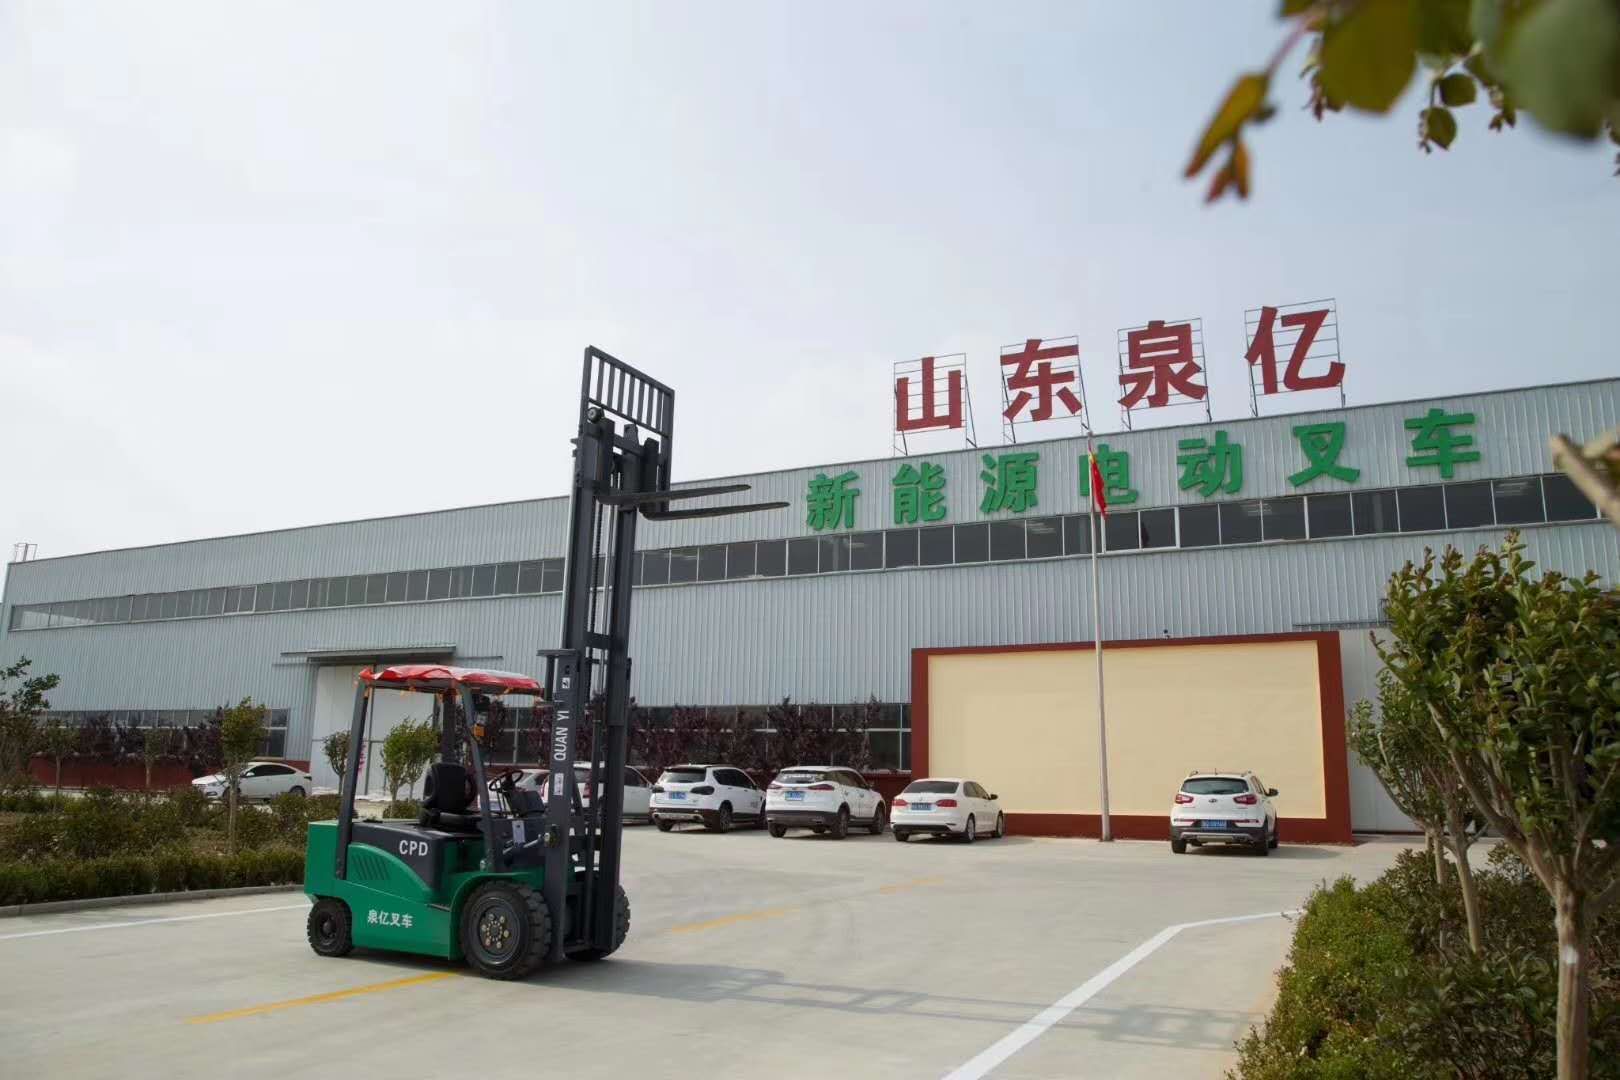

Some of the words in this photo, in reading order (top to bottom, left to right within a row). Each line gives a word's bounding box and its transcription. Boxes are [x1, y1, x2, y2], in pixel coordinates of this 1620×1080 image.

[896, 305, 1344, 431] 山东泉亿
[806, 408, 1481, 530] 新能源电动叉车
[556, 710, 570, 721] YI
[553, 726, 568, 761] QUAN
[399, 839, 429, 857] CPD
[367, 908, 414, 929] 泉亿叉车
